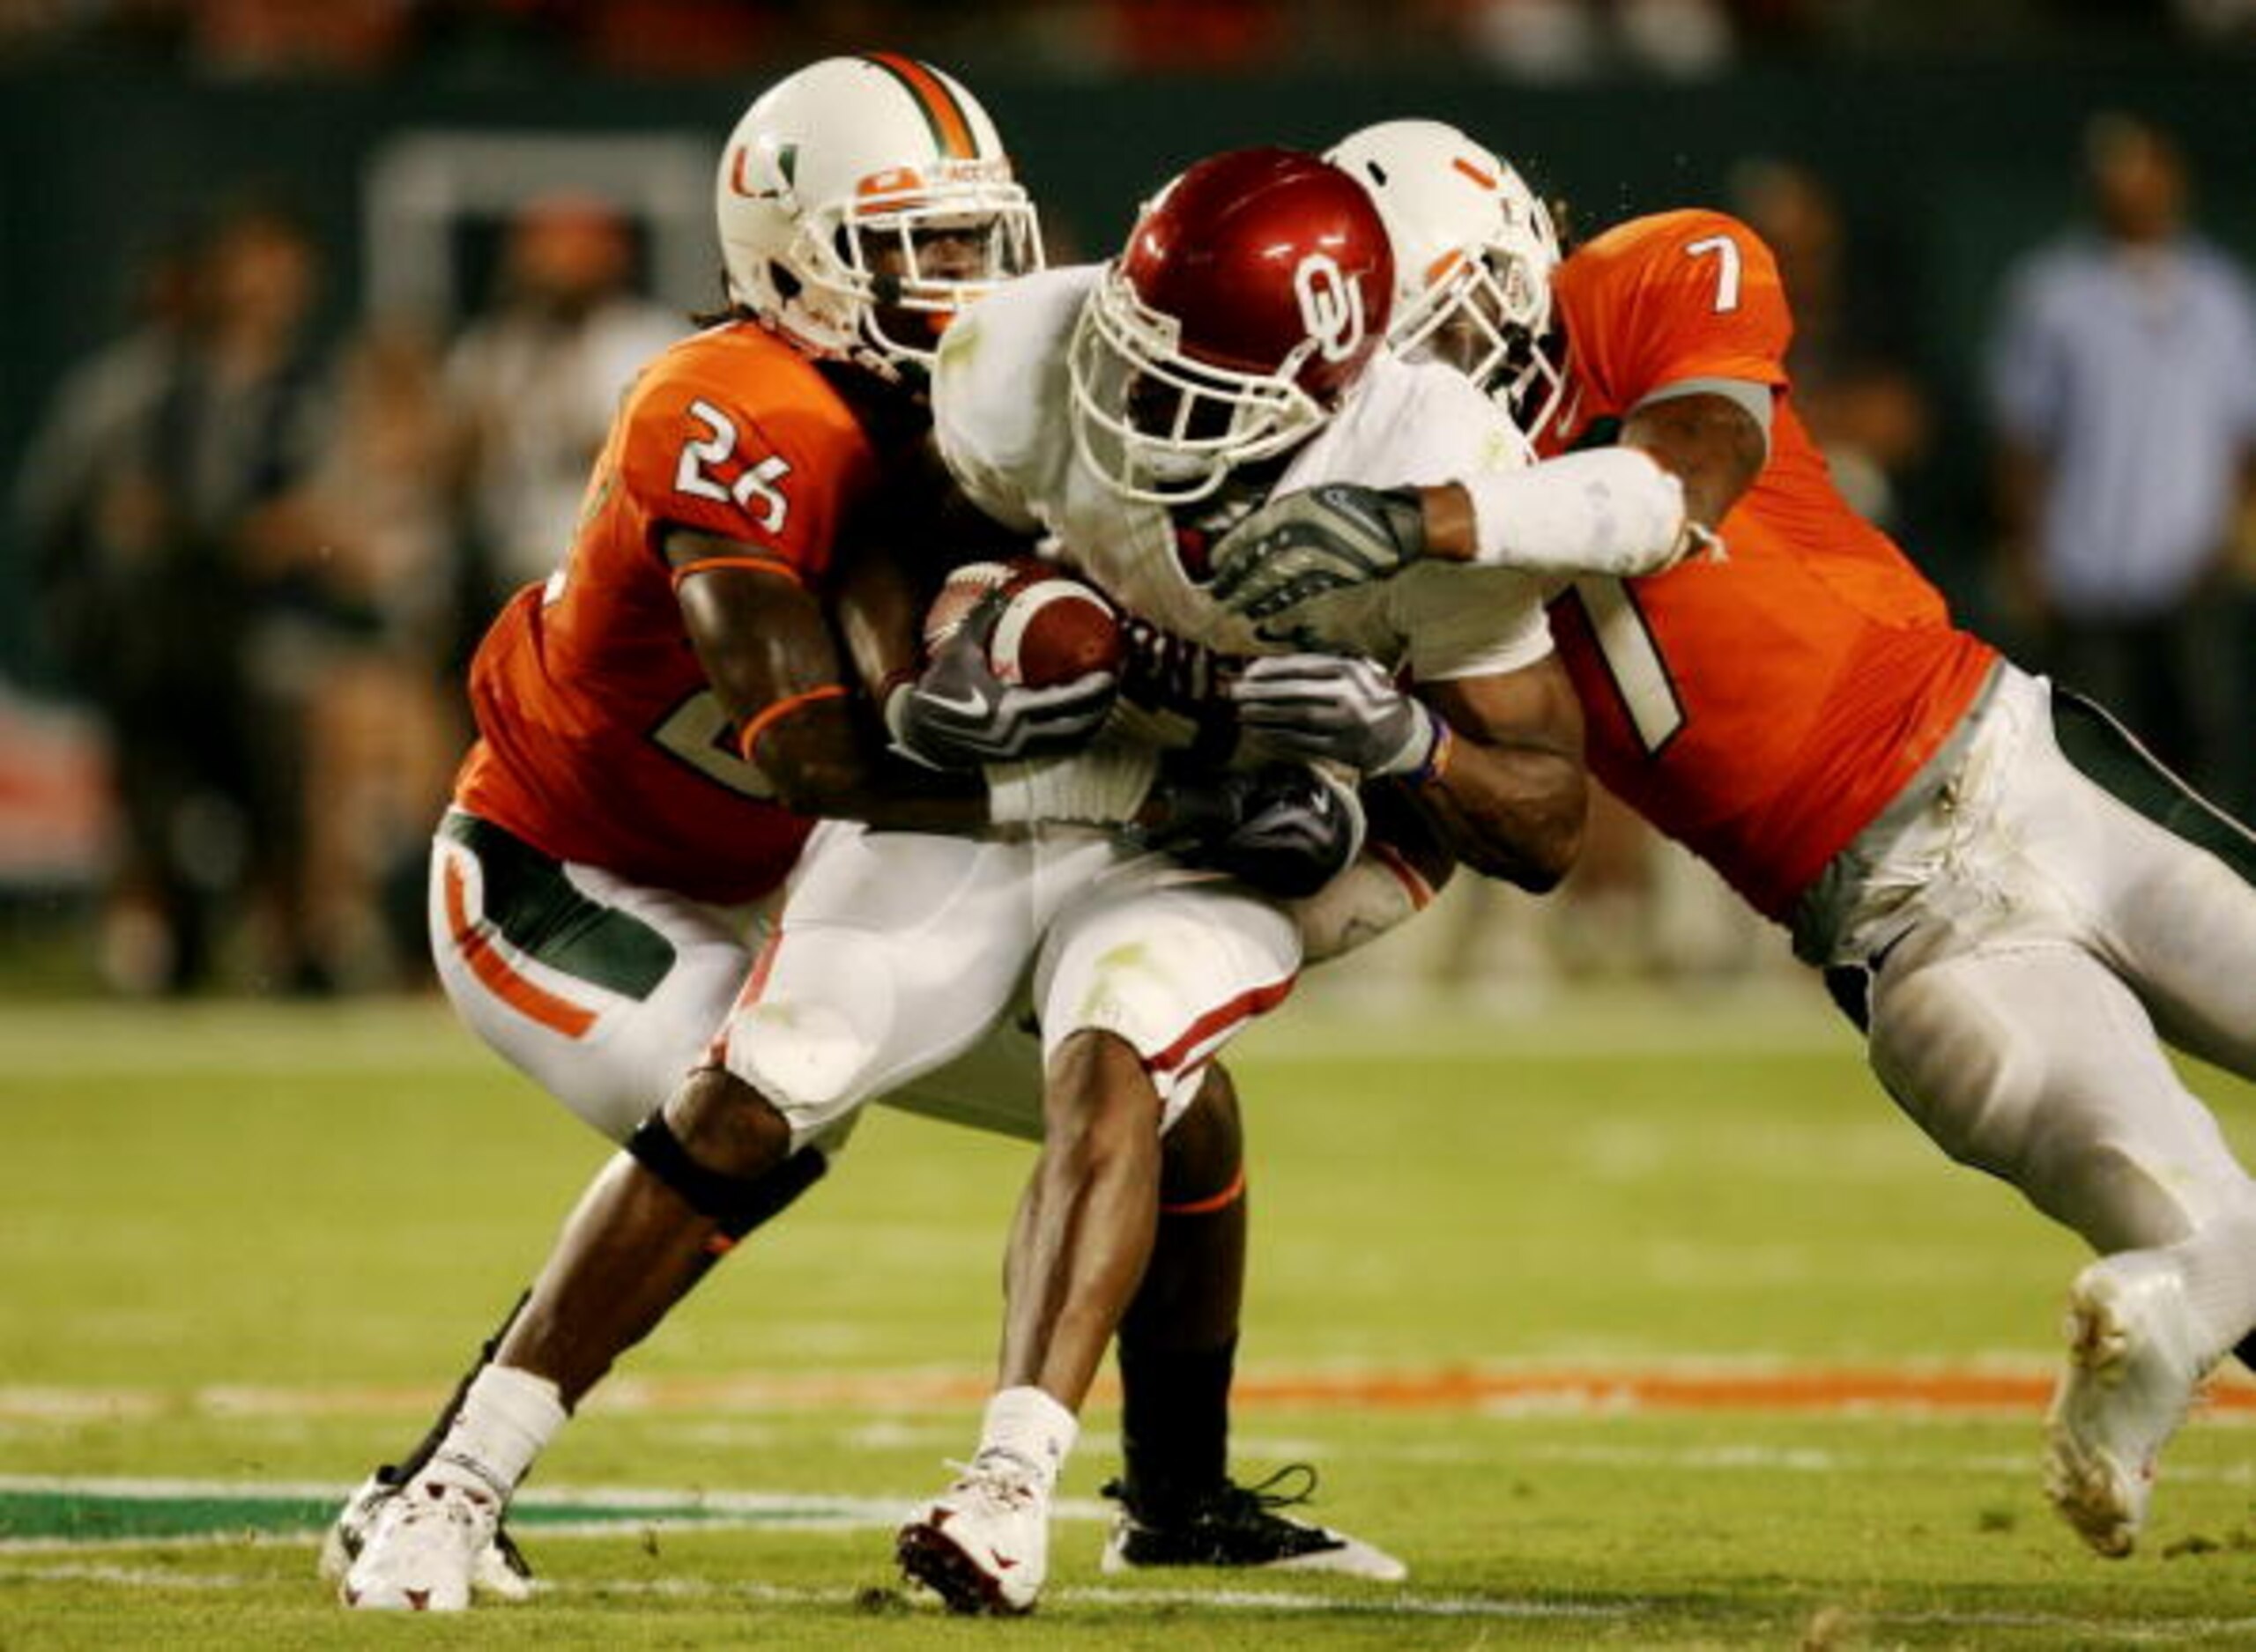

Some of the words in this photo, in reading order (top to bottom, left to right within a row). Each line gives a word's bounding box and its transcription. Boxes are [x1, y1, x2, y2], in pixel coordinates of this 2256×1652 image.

[1295, 253, 1364, 362] OU
[1685, 234, 1740, 313] 7
[675, 399, 790, 533] 26
